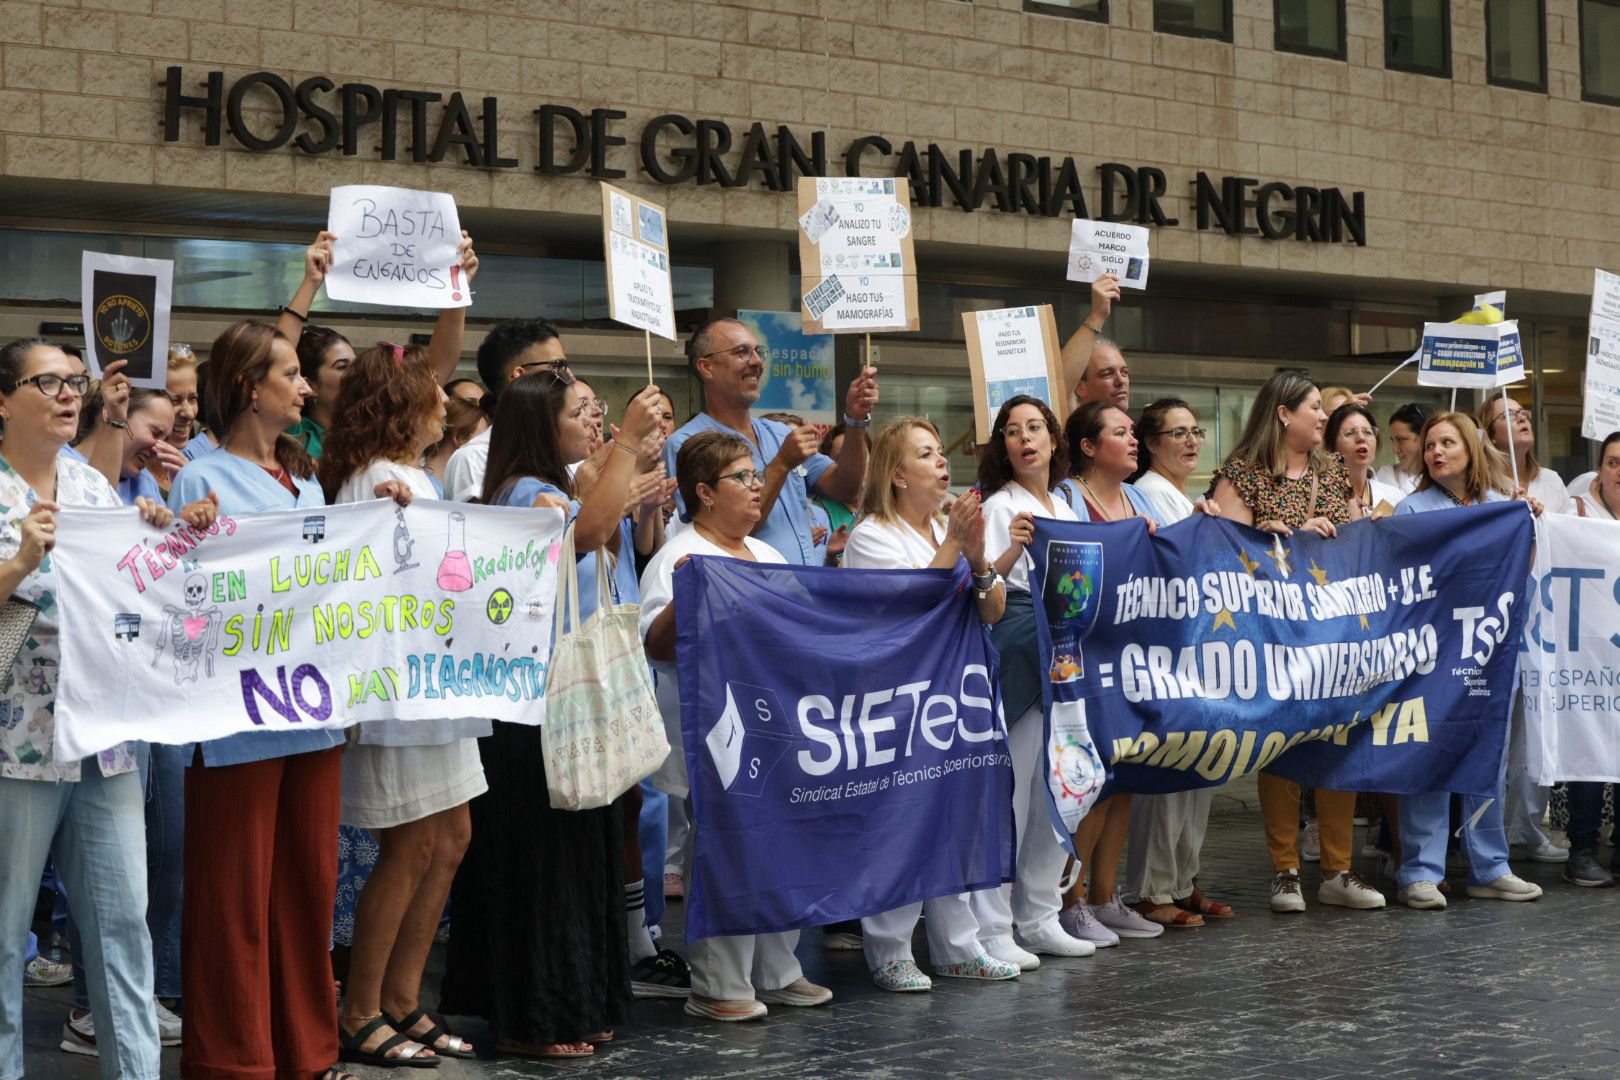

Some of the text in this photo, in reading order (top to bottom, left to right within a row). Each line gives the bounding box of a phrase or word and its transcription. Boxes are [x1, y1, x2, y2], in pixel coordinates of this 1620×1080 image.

[162, 66, 1366, 247] HOSPITAL DE GRAN CANARIA DR. NEGRIN
[854, 202, 864, 213] YO
[352, 198, 445, 239] BASTA
[838, 219, 882, 230] ANALIZO TU
[846, 236, 876, 246] SANGRE
[1094, 230, 1132, 241] ACUERDO
[390, 243, 416, 257] DE
[1098, 242, 1126, 252] MARCO
[1101, 255, 1124, 264] SIGLO
[859, 276, 869, 286] YO
[846, 292, 884, 303] HAGO TUS
[836, 306, 894, 320] MAMOGRAFÍAS
[773, 361, 832, 379] sin humo
[212, 569, 247, 602] EN
[270, 545, 381, 593] LUCHA
[1113, 573, 1199, 625] TÉCNICO
[1305, 572, 1387, 621] SANITARIO
[223, 603, 294, 657] SIN
[1120, 639, 1258, 704] GRADO
[1263, 623, 1438, 701] UNIVERSITARIO
[239, 663, 333, 726] NO
[347, 667, 400, 708] HAY
[755, 699, 772, 722] S
[1370, 696, 1430, 746] YA
[749, 757, 761, 779] S
[790, 786, 843, 804] Sindicat
[845, 780, 879, 799] Estatal
[879, 776, 890, 791] de
[892, 762, 942, 786] Tècnics
